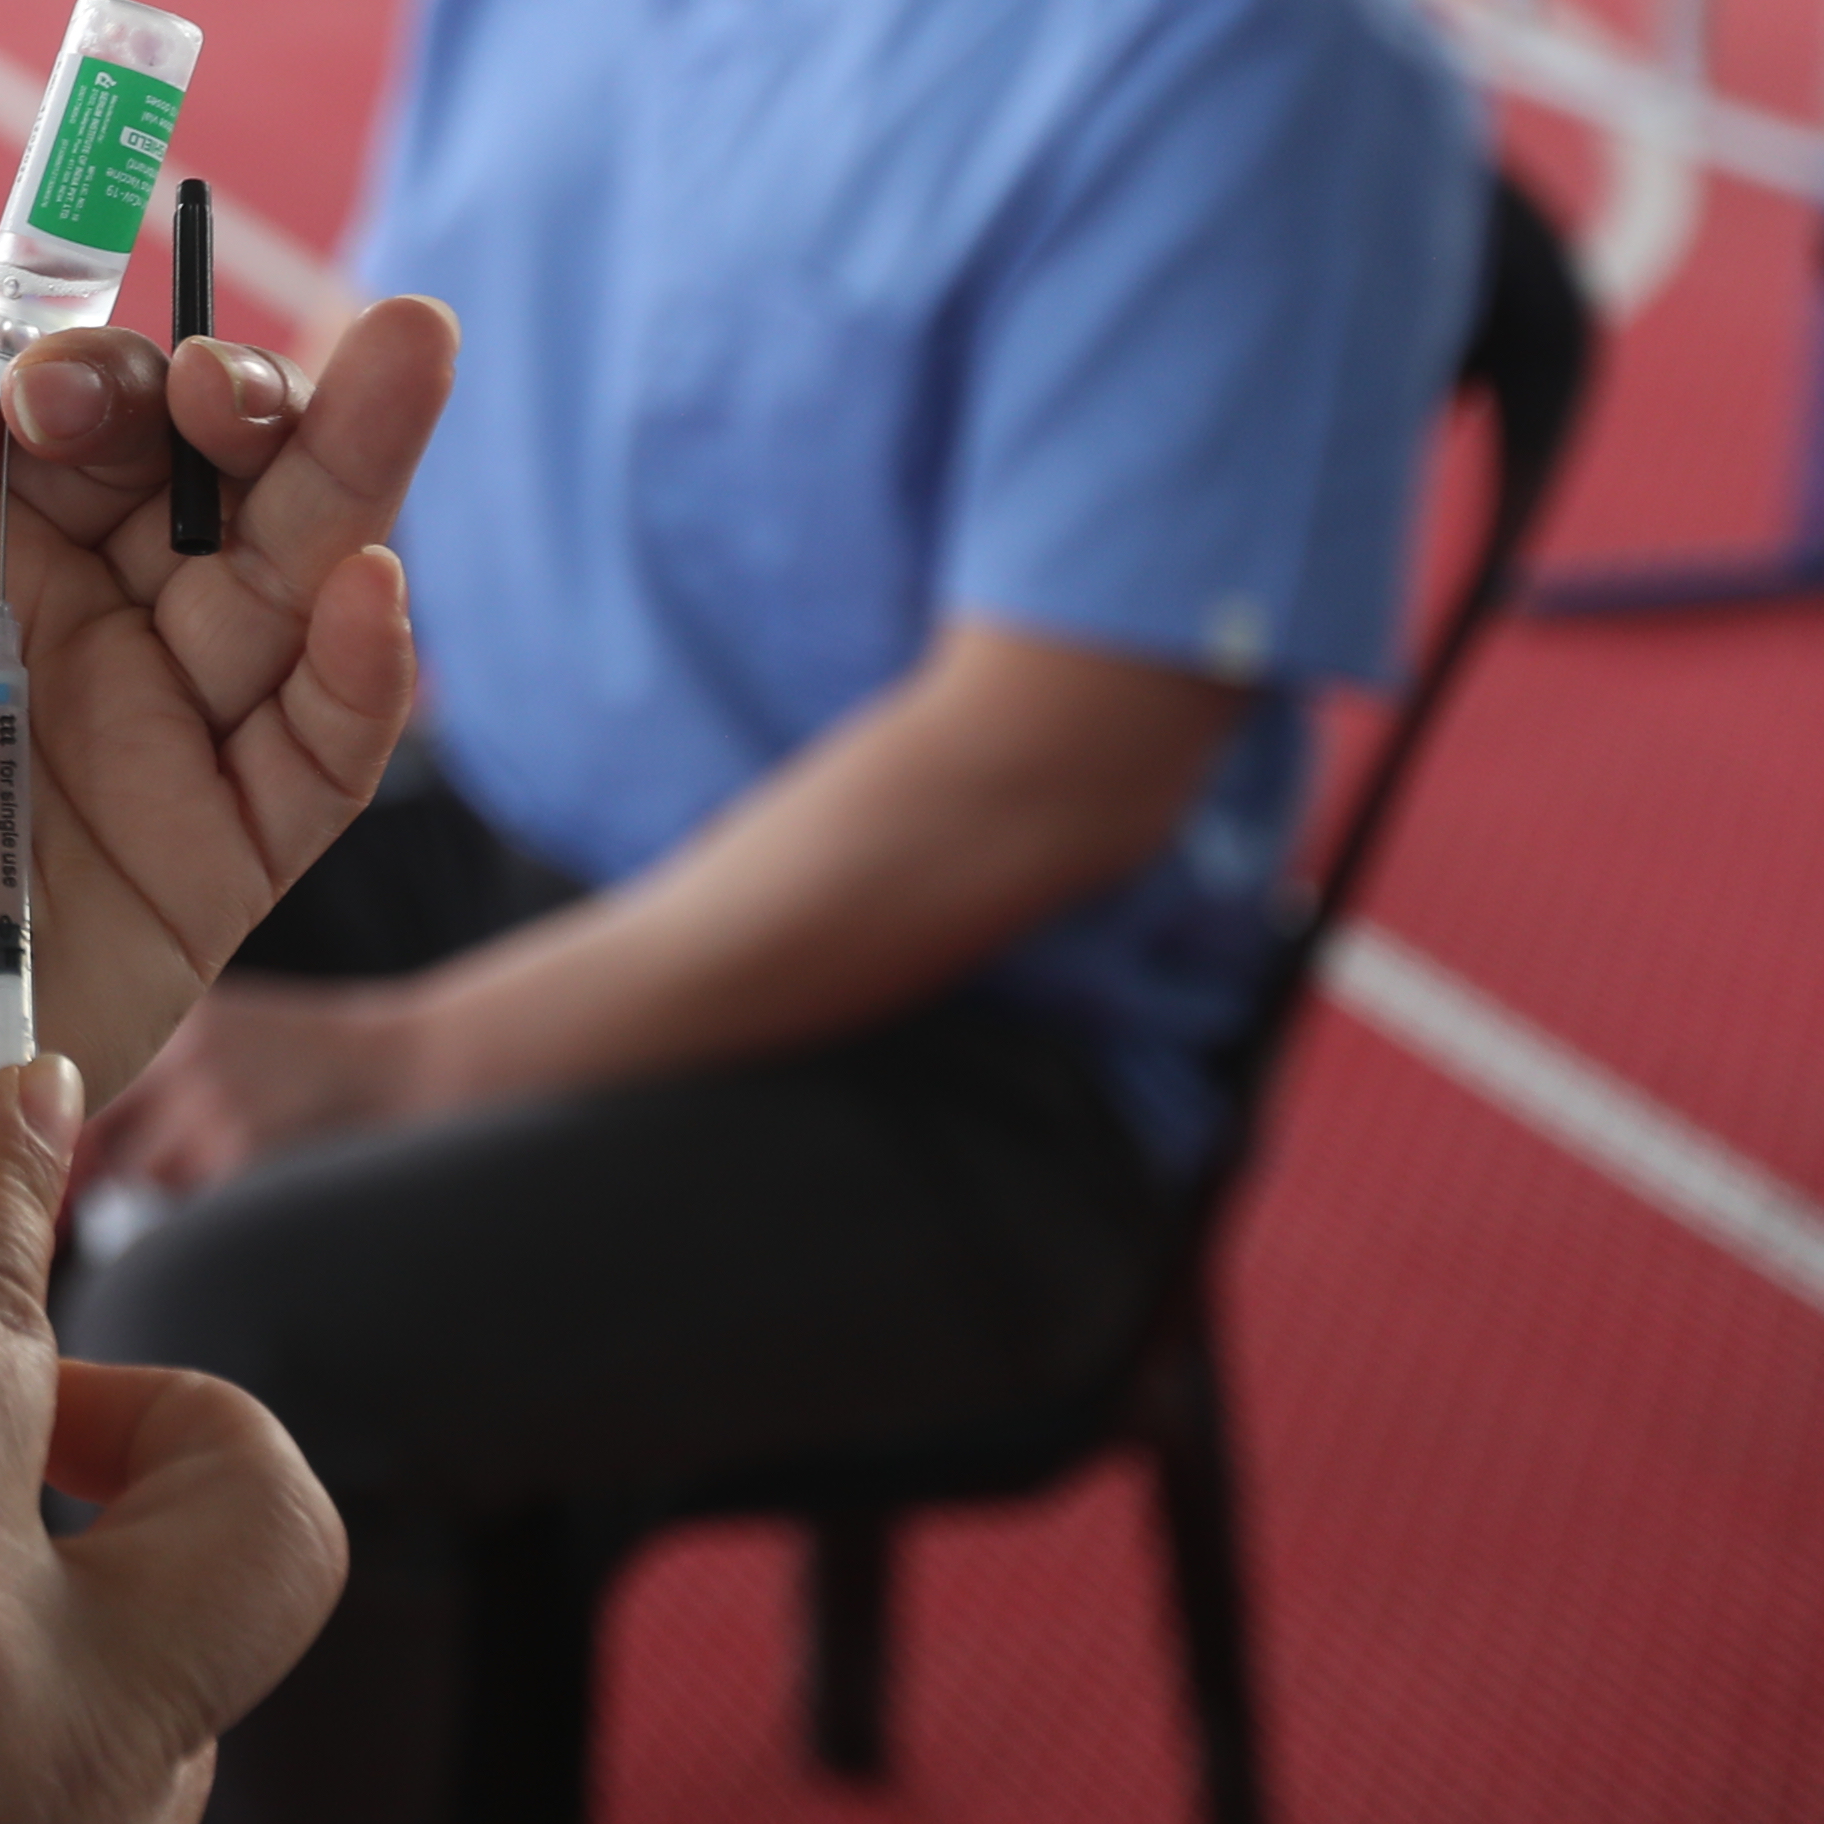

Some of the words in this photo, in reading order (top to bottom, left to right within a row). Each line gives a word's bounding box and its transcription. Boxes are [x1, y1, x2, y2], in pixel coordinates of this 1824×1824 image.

[93, 89, 110, 118] SERUM
[80, 116, 101, 155] INSTITUTE
[77, 153, 88, 166] OF
[70, 165, 84, 186] INDIA
[0, 759, 17, 787] for
[0, 852, 18, 888] use
